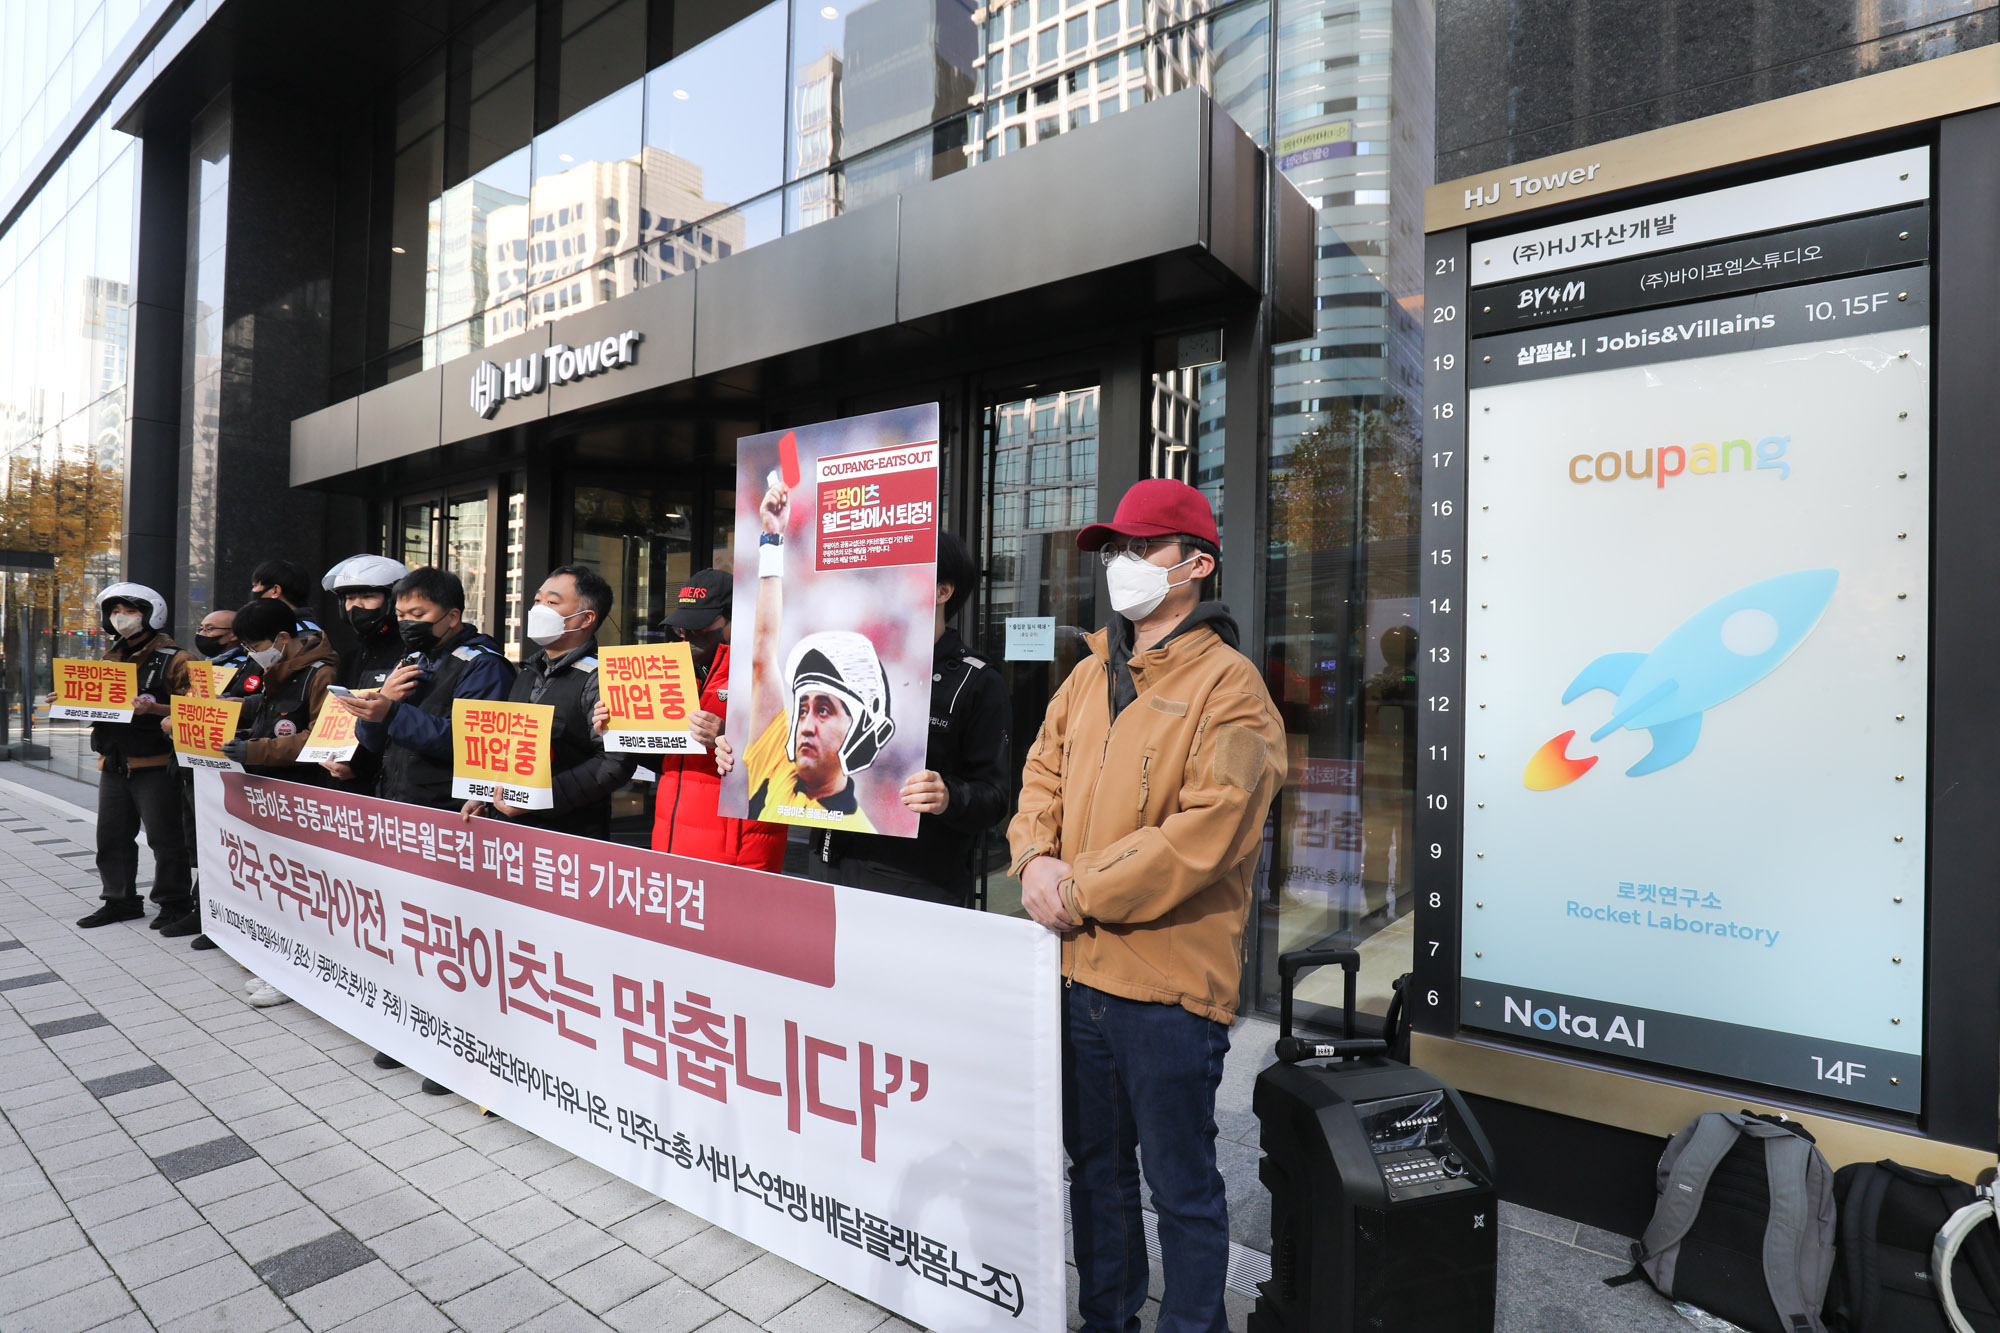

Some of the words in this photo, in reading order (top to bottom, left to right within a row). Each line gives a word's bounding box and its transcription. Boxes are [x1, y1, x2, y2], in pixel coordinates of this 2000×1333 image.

[1464, 183, 1500, 210] HJ
[1510, 162, 1600, 198] Tower
[1513, 213, 1677, 265] (주)HJ자산개발
[1435, 257, 1456, 276] 21
[1640, 245, 1823, 291] (주)바이포엠스튜디오
[1517, 280, 1586, 309] BY4M
[1433, 305, 1456, 324] 20
[1596, 313, 1776, 353] Jobis&Villains
[1841, 292, 1890, 317] 15F
[504, 353, 540, 398] HJ
[545, 330, 640, 385] Tower
[1433, 354, 1455, 372] 19
[1432, 403, 1454, 420] 18
[823, 454, 907, 477] COUPANG-EATS
[907, 450, 933, 463] OUT
[1432, 451, 1453, 468] 17
[1569, 435, 1792, 489] coupang
[822, 483, 881, 511] 쿠팡이츠
[1431, 500, 1453, 517] 16
[822, 505, 895, 534] 월드컵에서
[895, 501, 932, 525] 퇴장!
[1430, 550, 1452, 566] 15
[1429, 599, 1451, 615] 14
[1428, 647, 1450, 663] 13
[64, 665, 127, 682] 쿠팡이츠는
[606, 655, 681, 681] 쿠팡이츠는
[64, 680, 103, 703] 파업
[108, 683, 127, 704] 중
[608, 684, 655, 720] 파업
[659, 683, 686, 720] 중
[1428, 696, 1450, 712] 12
[64, 709, 89, 718] 쿠팡이츠
[178, 704, 228, 725] 쿠팡이츠는
[464, 710, 539, 739] 쿠팡이츠는
[178, 723, 206, 750] 파업
[209, 726, 224, 752] 중
[317, 716, 353, 740] 파업
[619, 736, 646, 748] 쿠팡이츠
[648, 736, 688, 748] 공동교섭단
[1428, 745, 1448, 761] 11
[465, 736, 510, 773] 파업
[514, 740, 537, 776] 중
[501, 787, 530, 804] 동교섭단
[1426, 794, 1448, 811] 10
[777, 804, 805, 818] 쿠팡이츠
[806, 807, 844, 822] 공동교섭단
[243, 785, 293, 823] 쿠팡이츠
[293, 795, 365, 844] 공동교섭단
[368, 812, 475, 873] 카타르월드컵
[482, 837, 524, 886] 파업
[532, 846, 579, 900] 돌입
[588, 861, 705, 931] 기자회견
[1430, 843, 1442, 859] 9
[1429, 892, 1441, 908] 8
[1617, 881, 1723, 910] 로켓연구소
[1566, 900, 1641, 926] Rocket
[1647, 911, 1780, 948] Laboratory
[1428, 941, 1440, 957] 7
[1427, 990, 1439, 1006] 6
[400, 900, 601, 1051] 쿠팡이츠는
[612, 973, 928, 1163] 멈춥니다”
[1504, 995, 1600, 1041] Nota
[1604, 1014, 1645, 1049] AI
[1811, 1055, 1867, 1085] 14F
[294, 943, 311, 969] 장소
[382, 989, 402, 1024] 주최
[617, 1106, 693, 1170] 민주노총
[695, 1143, 809, 1223] 서비스연맹
[810, 1192, 1025, 1318] 배달플랫폼노조)
